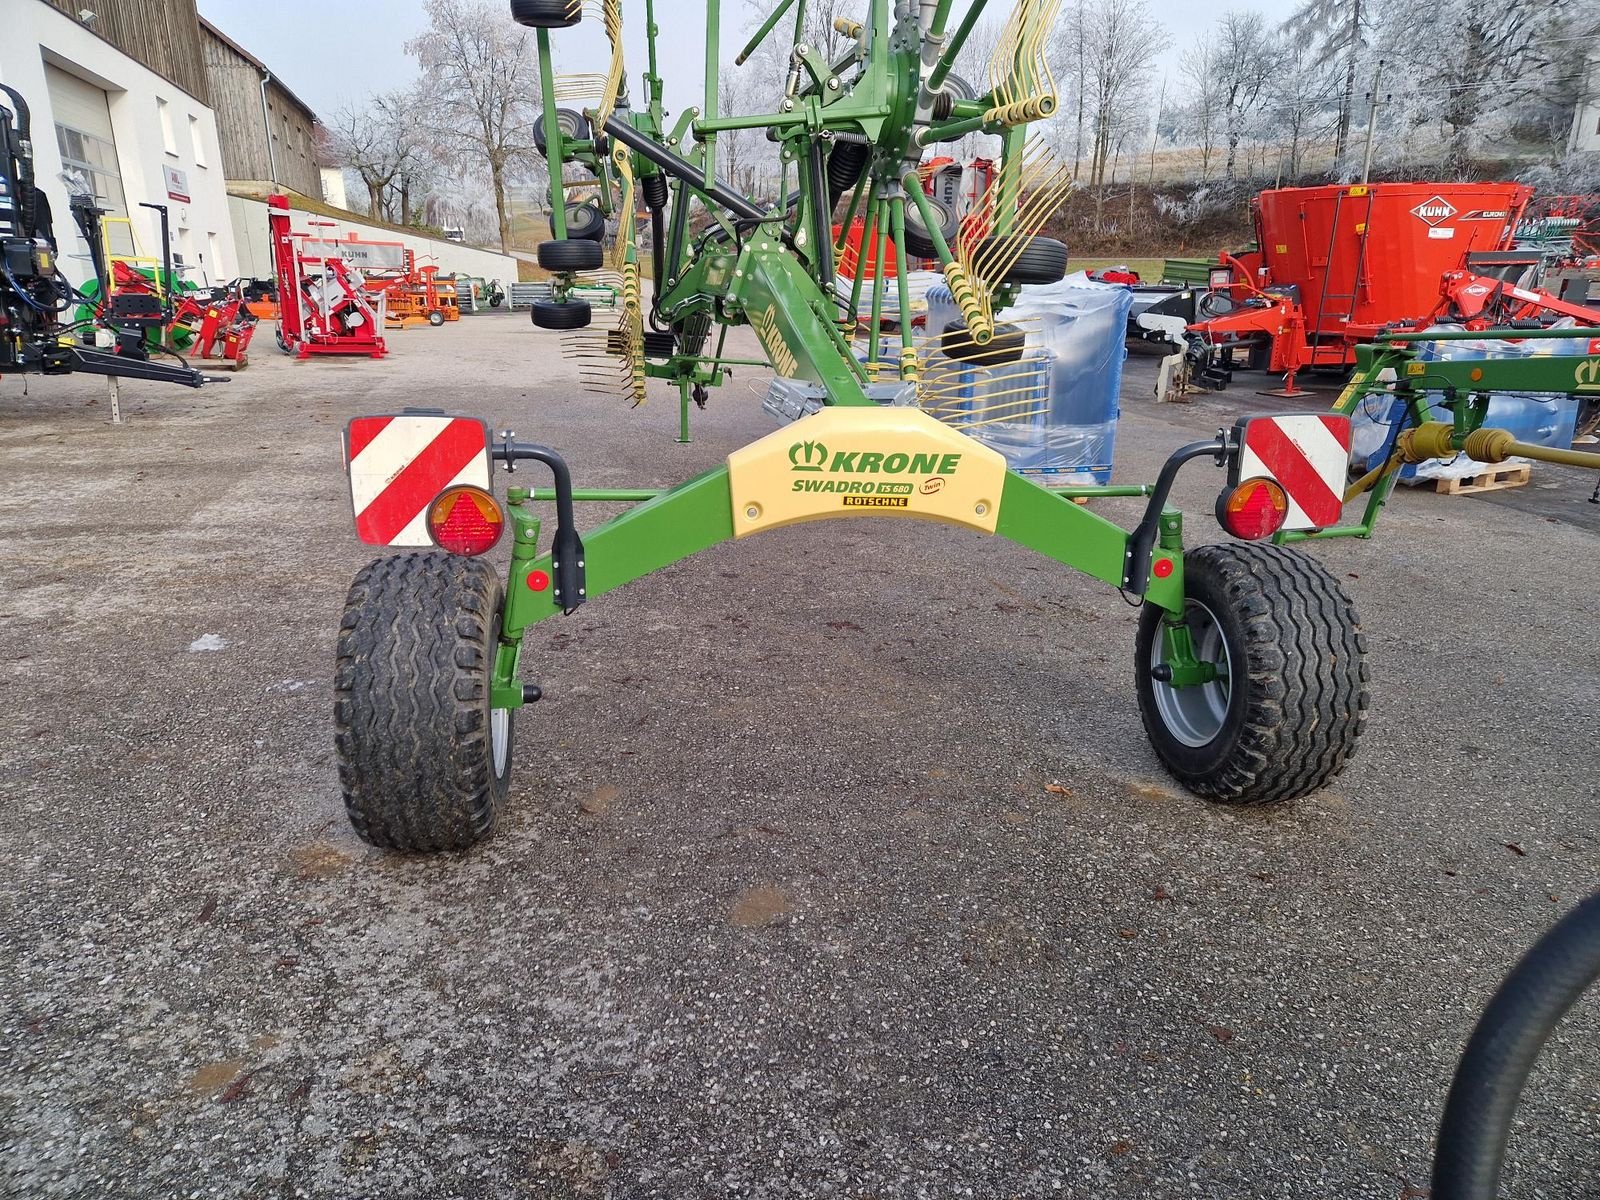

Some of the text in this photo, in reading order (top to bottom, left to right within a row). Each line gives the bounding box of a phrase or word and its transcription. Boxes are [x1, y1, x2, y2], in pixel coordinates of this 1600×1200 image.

[944, 177, 953, 208] KUH
[1419, 206, 1450, 217] KUHN
[341, 250, 368, 259] KUHN
[764, 321, 799, 378] KRONE
[829, 452, 962, 475] KRONE
[791, 479, 909, 494] SWADRO TS 680
[924, 482, 941, 491] Twin
[846, 496, 906, 507] ROTSCHNE
